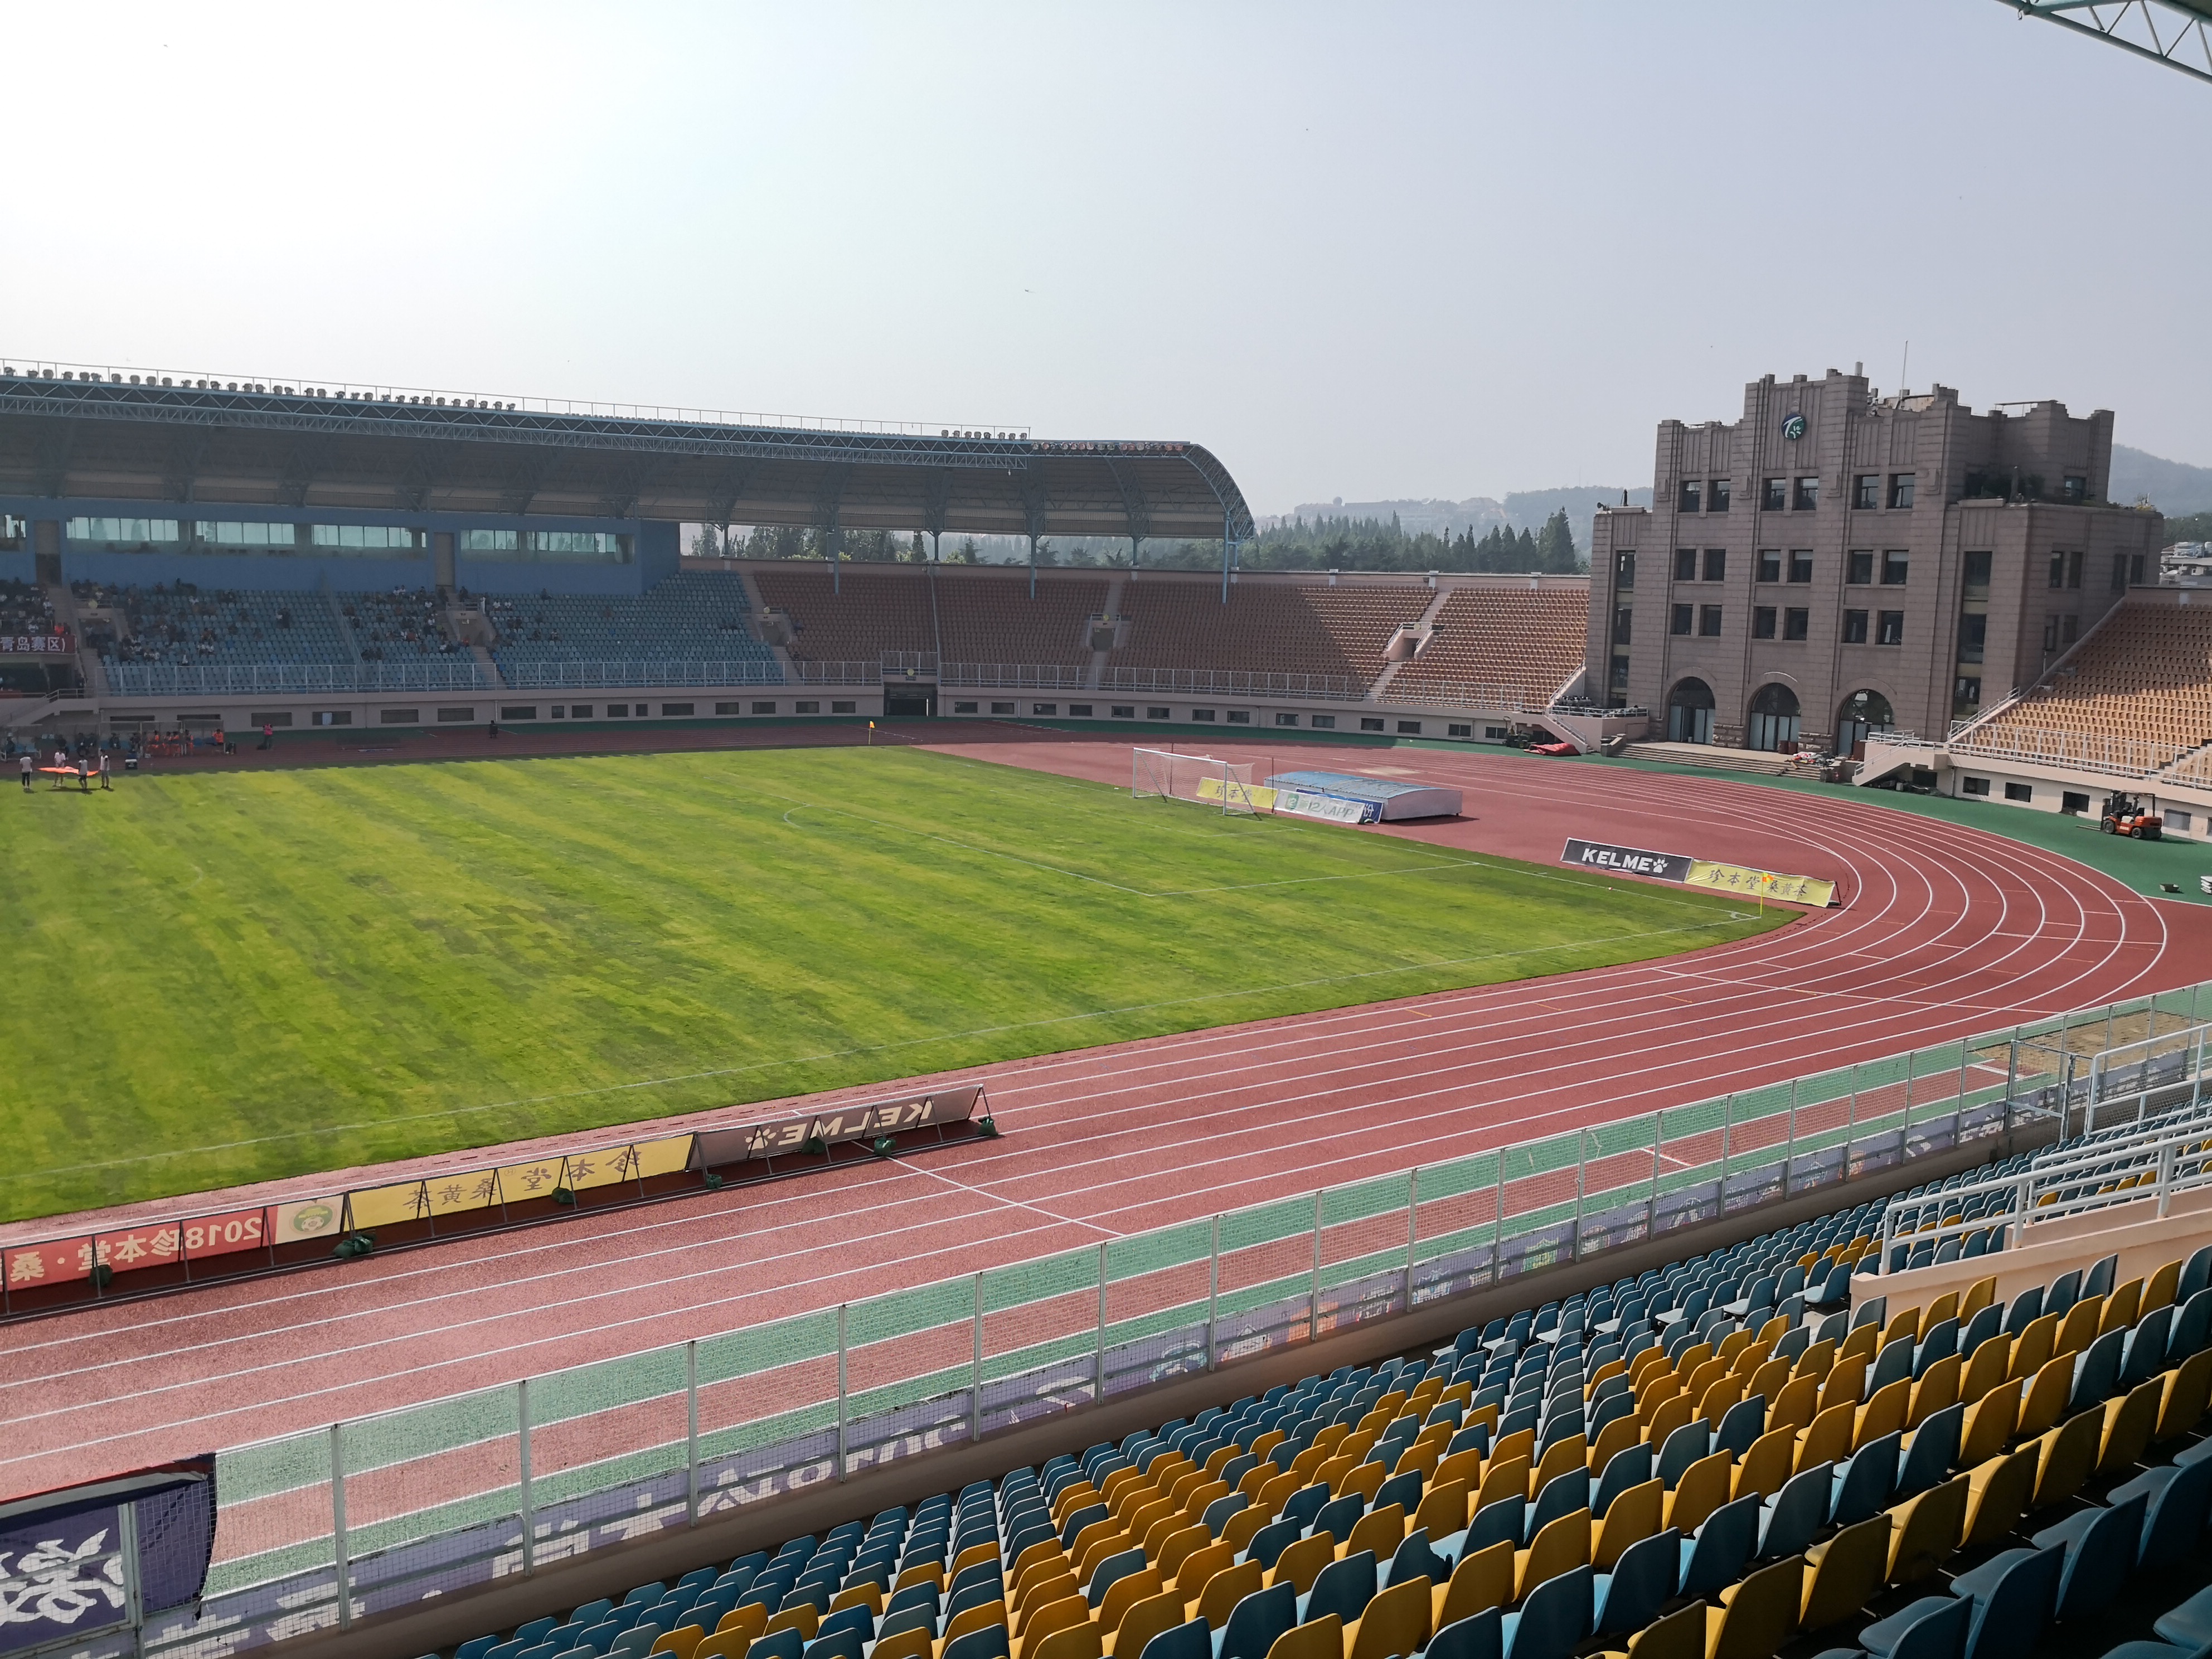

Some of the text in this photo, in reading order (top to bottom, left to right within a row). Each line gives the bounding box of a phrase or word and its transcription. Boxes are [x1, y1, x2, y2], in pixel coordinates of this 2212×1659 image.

[1582, 848, 1653, 871] KELME
[1709, 869, 1760, 890] 珍本堂
